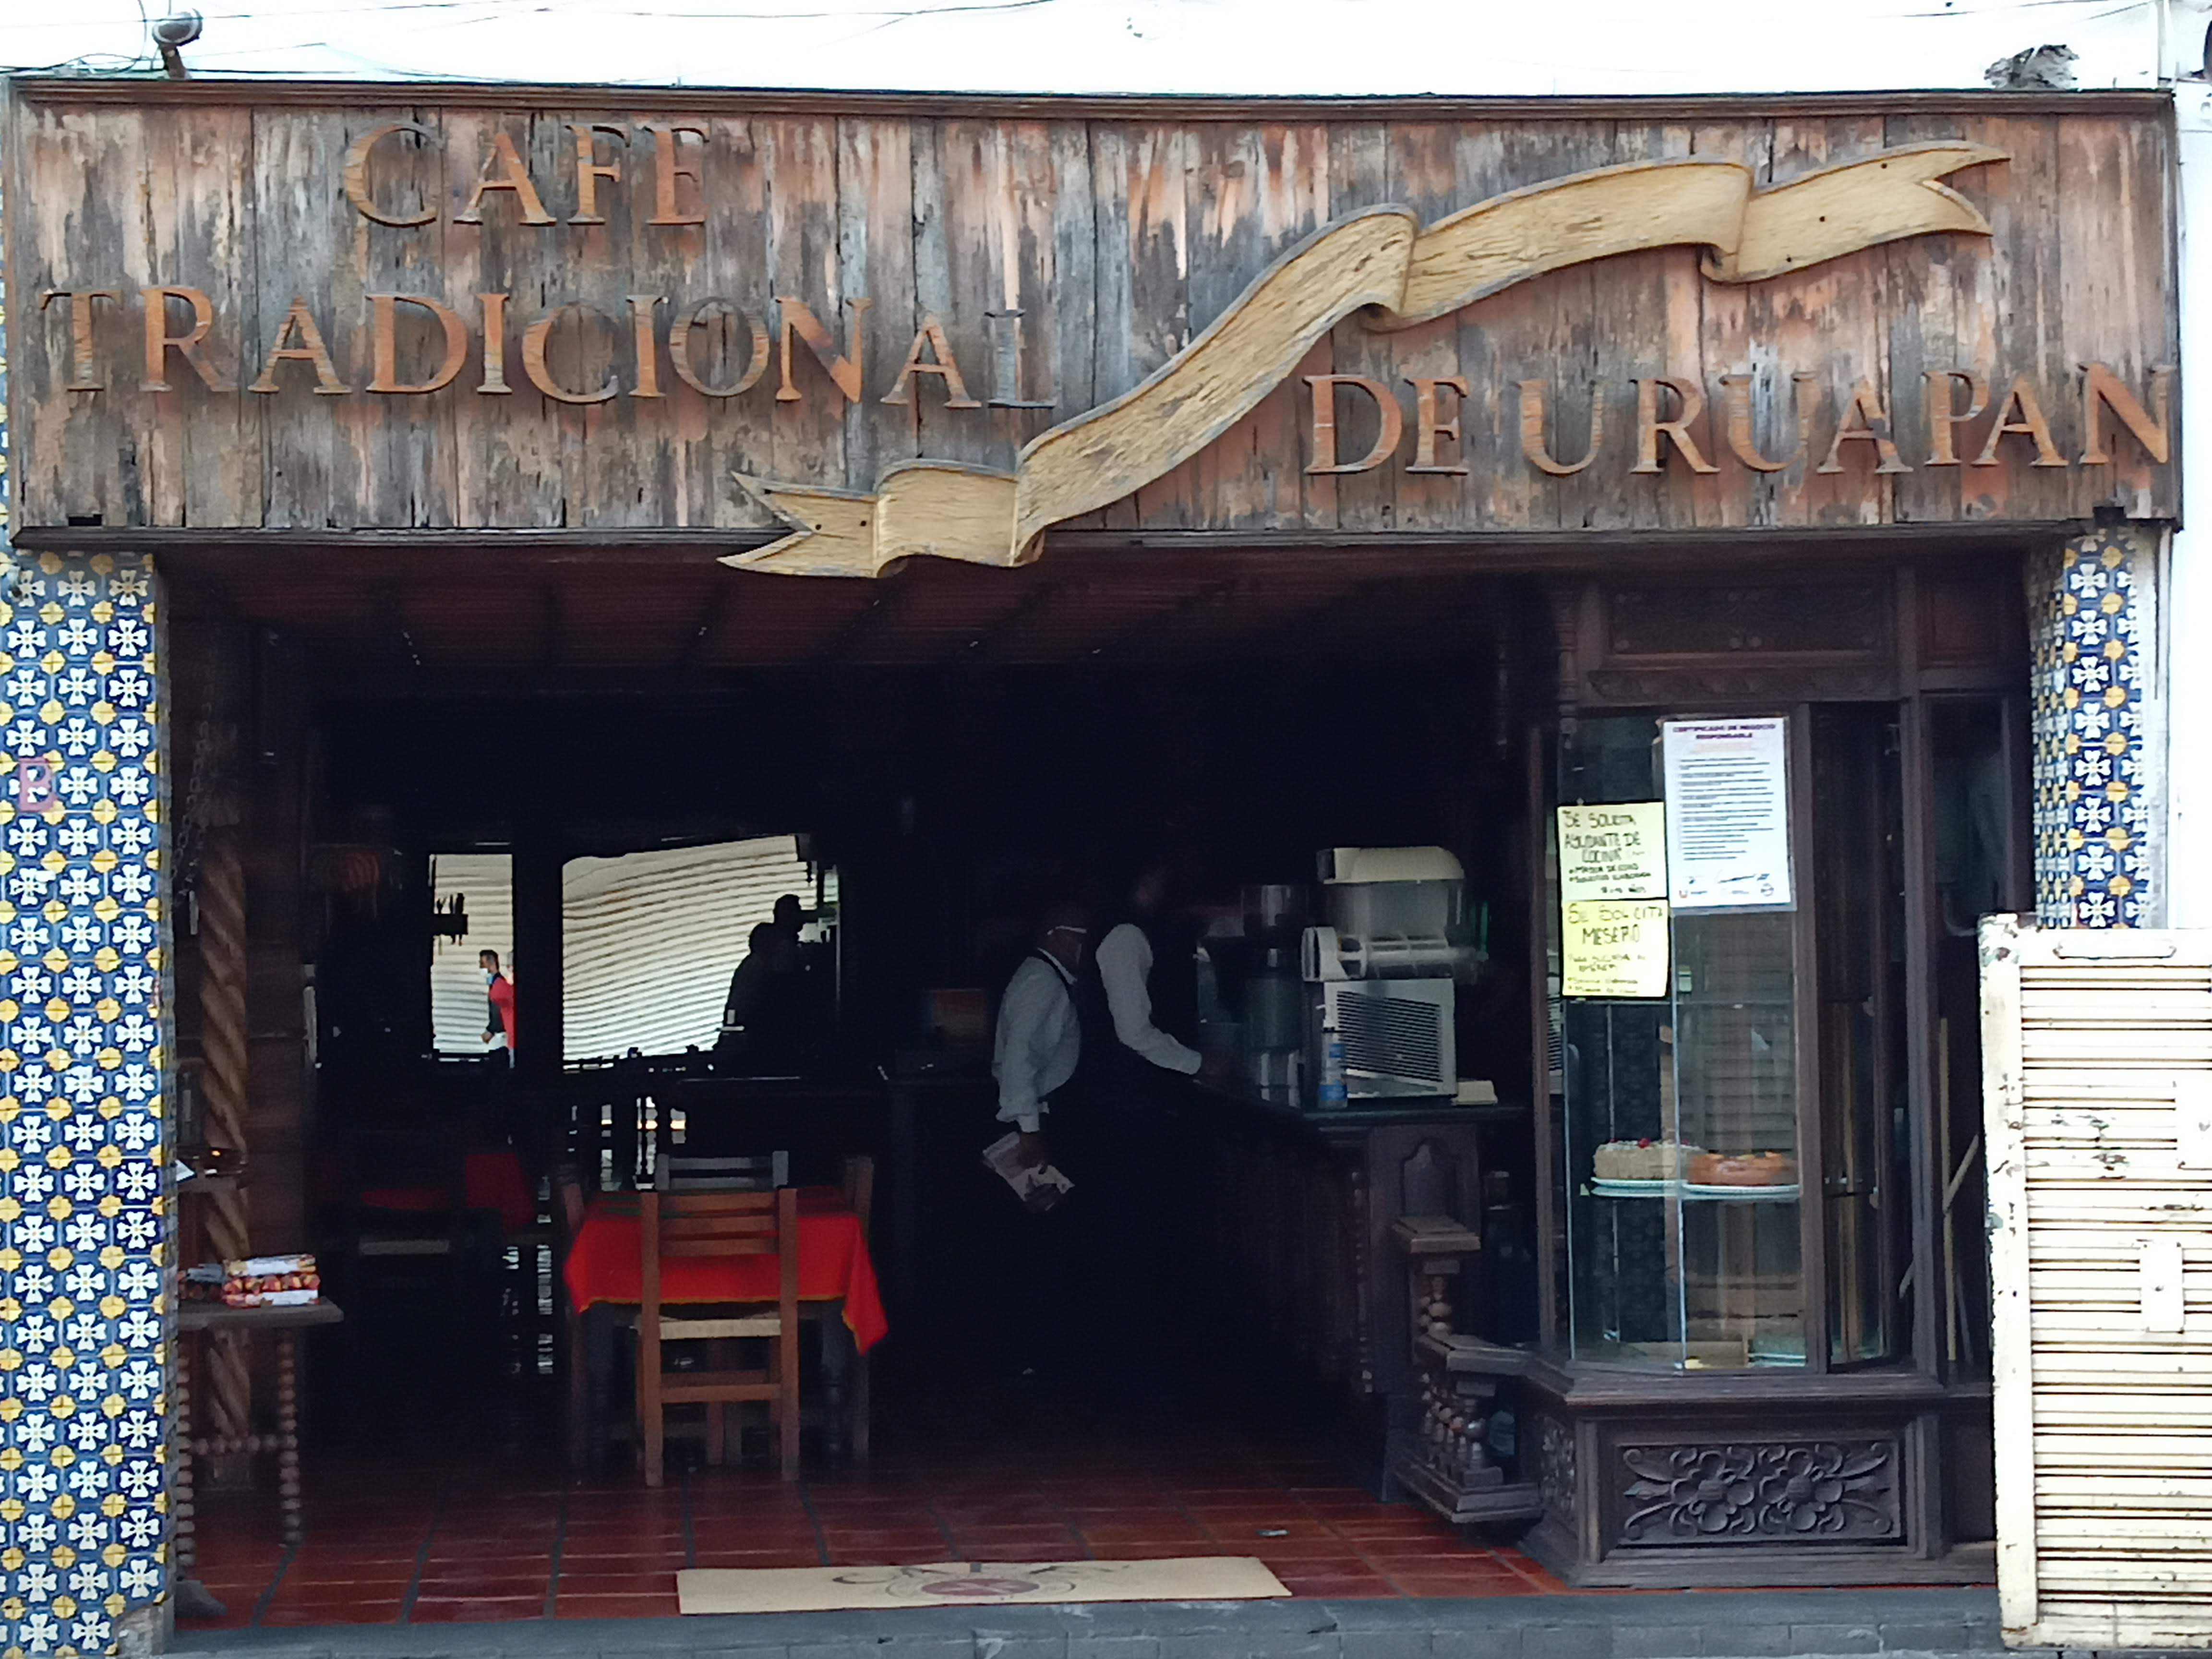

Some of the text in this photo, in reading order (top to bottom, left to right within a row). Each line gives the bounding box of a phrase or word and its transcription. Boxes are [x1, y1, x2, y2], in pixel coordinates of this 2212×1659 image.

[344, 121, 710, 228] CAFE
[39, 285, 1058, 411] TRADICIONAL
[1303, 363, 2172, 476] DE URUAPAN
[1562, 810, 1581, 828] SE
[1623, 831, 1641, 846] DE
[1599, 904, 1663, 921] SOLCITA
[1582, 924, 1640, 945] MESERO
